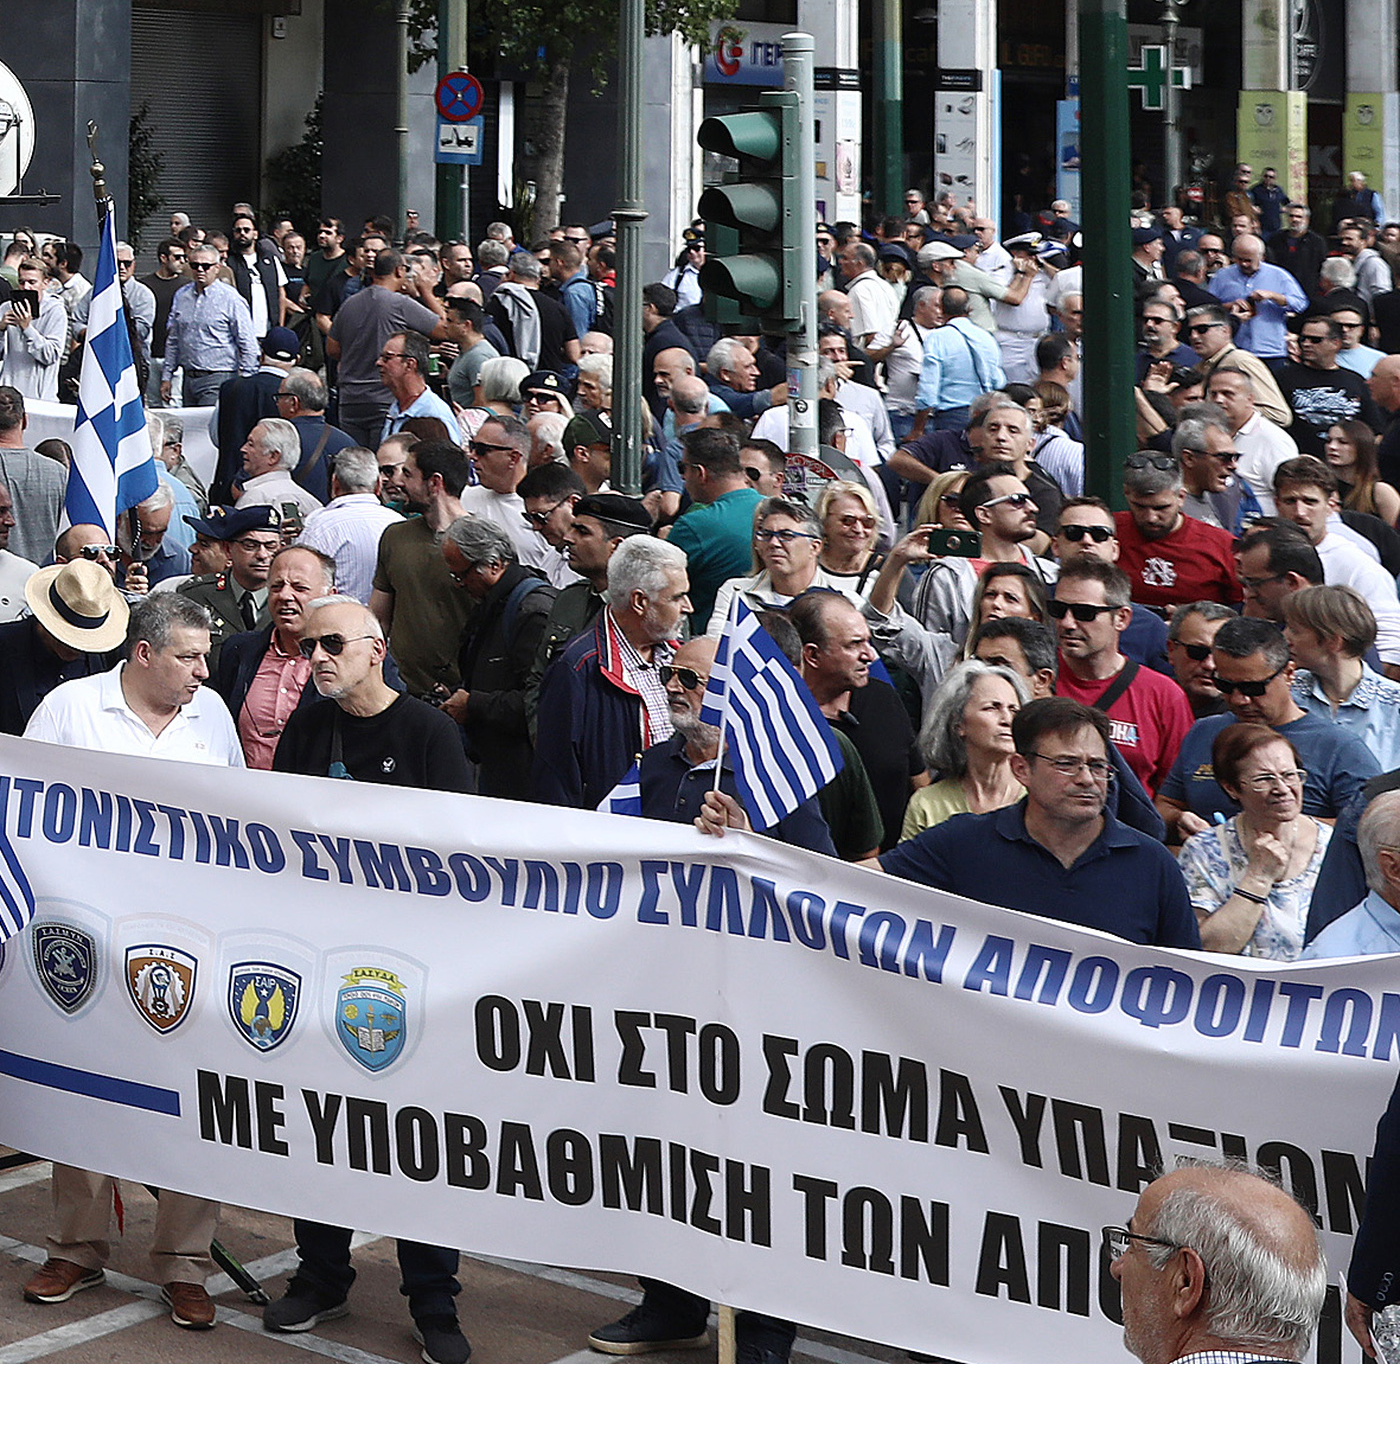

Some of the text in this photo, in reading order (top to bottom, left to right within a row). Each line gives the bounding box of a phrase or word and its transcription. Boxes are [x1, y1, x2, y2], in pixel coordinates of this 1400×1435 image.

[290, 829, 624, 920] ΣΥΜΒΟΥΛΙΟ
[637, 859, 957, 984] ΣΥΛΛΟΓΩΝ
[476, 995, 596, 1083] ΟΧΙ
[613, 1009, 741, 1107] ΣΤΟ
[761, 1033, 990, 1154] ΣΩΜΑ
[197, 1069, 289, 1159] ΜΕ
[301, 1088, 771, 1250] ΥΠΟΒΑΘΜΙΣΗ
[792, 1173, 950, 1288] ΤΩΝ
